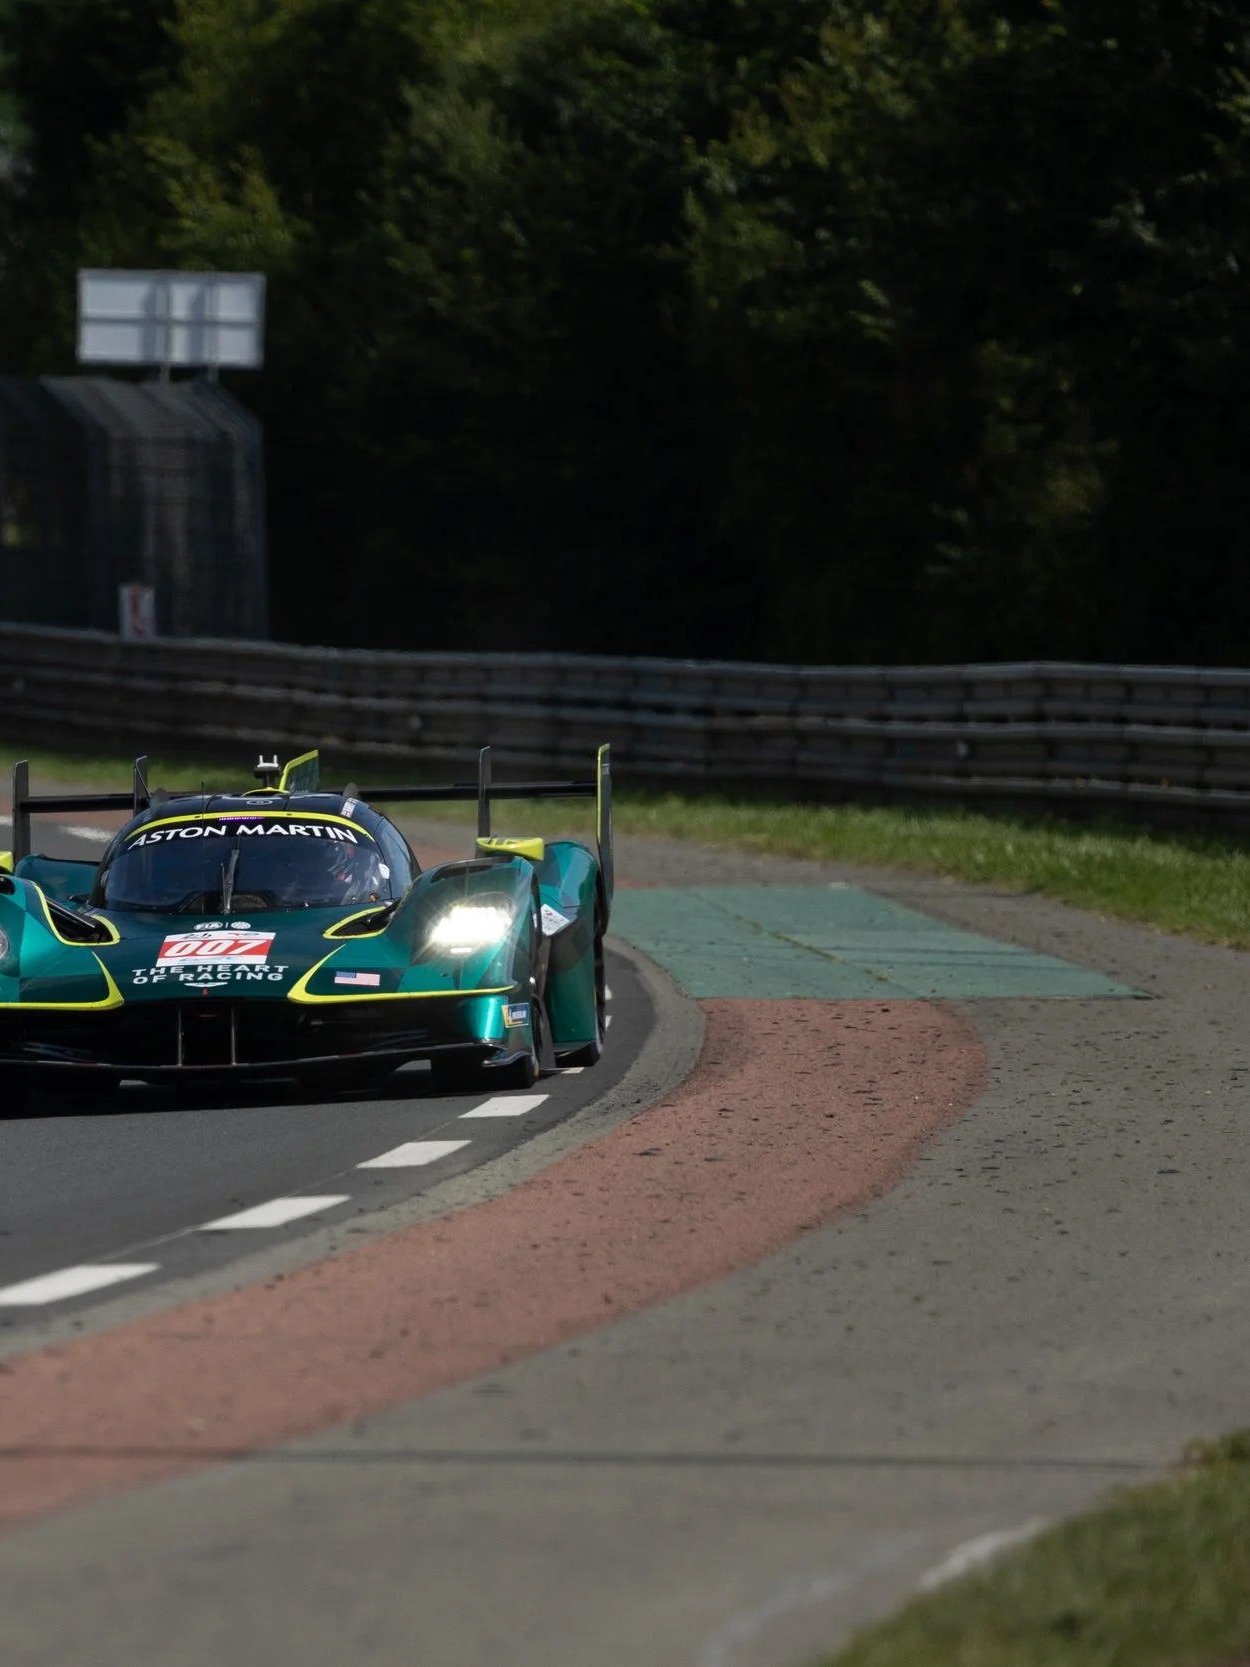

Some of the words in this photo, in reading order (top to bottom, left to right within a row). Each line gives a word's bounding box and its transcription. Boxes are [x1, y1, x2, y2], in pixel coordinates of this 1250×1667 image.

[128, 825, 225, 850] ASTON
[237, 824, 358, 844] MARTIN
[164, 940, 267, 957] 007
[132, 966, 184, 976] THE
[197, 964, 289, 973] HEART
[133, 974, 167, 984] OF
[179, 972, 284, 982] RACING
